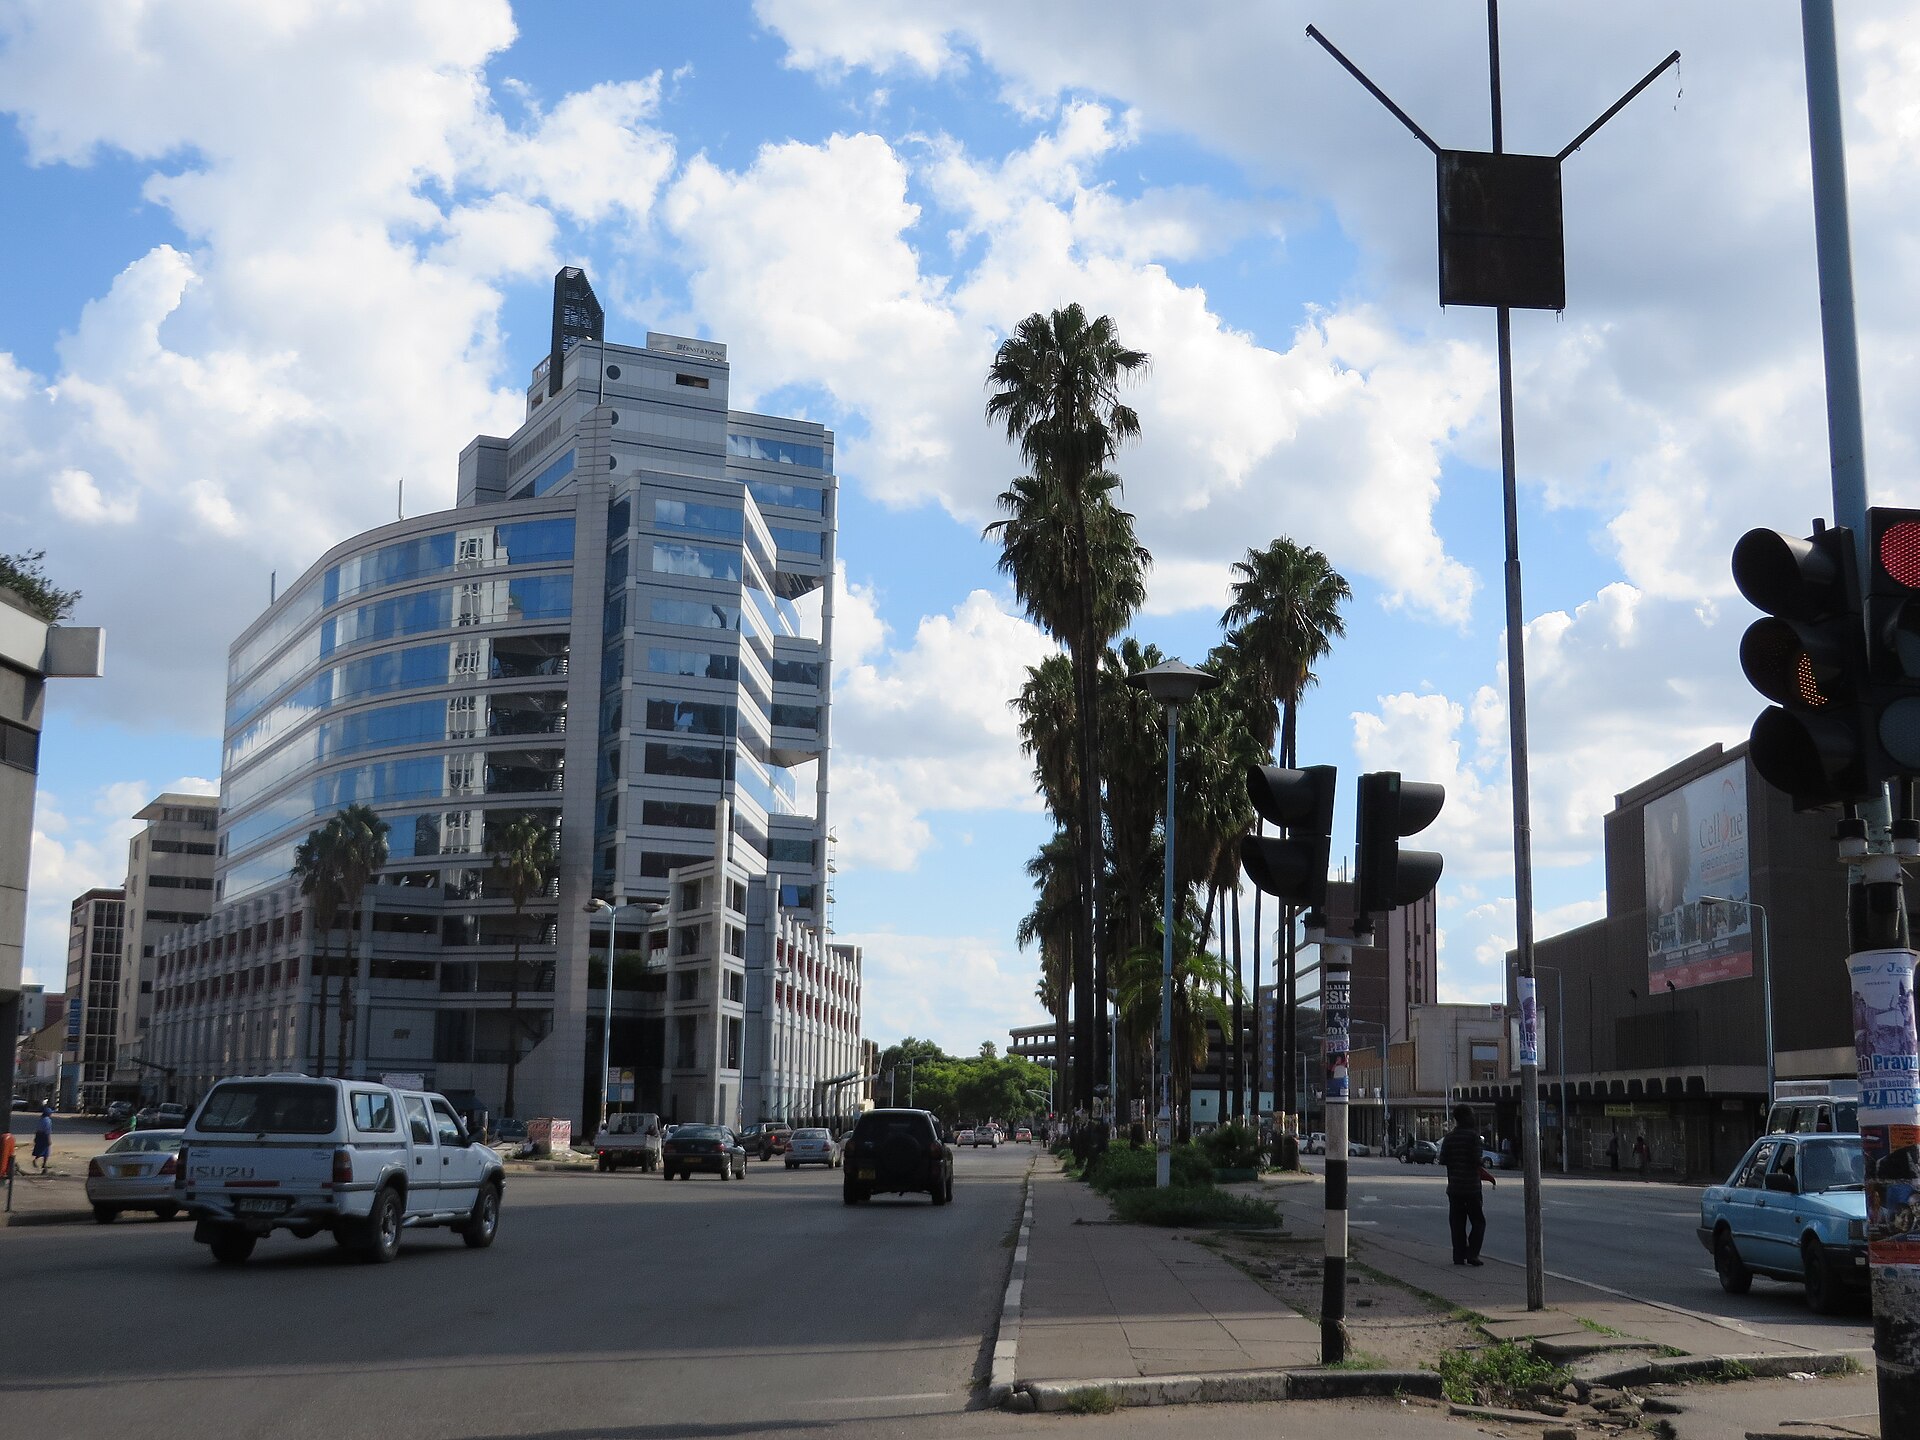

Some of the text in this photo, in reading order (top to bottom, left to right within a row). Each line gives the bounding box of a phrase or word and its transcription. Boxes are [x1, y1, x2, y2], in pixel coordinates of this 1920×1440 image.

[704, 348, 725, 356] YOUNG
[1327, 1026, 1347, 1035] 2014
[1868, 1090, 1881, 1104] 27
[1886, 1090, 1912, 1105] DEC
[189, 1166, 256, 1179] ISUZU
